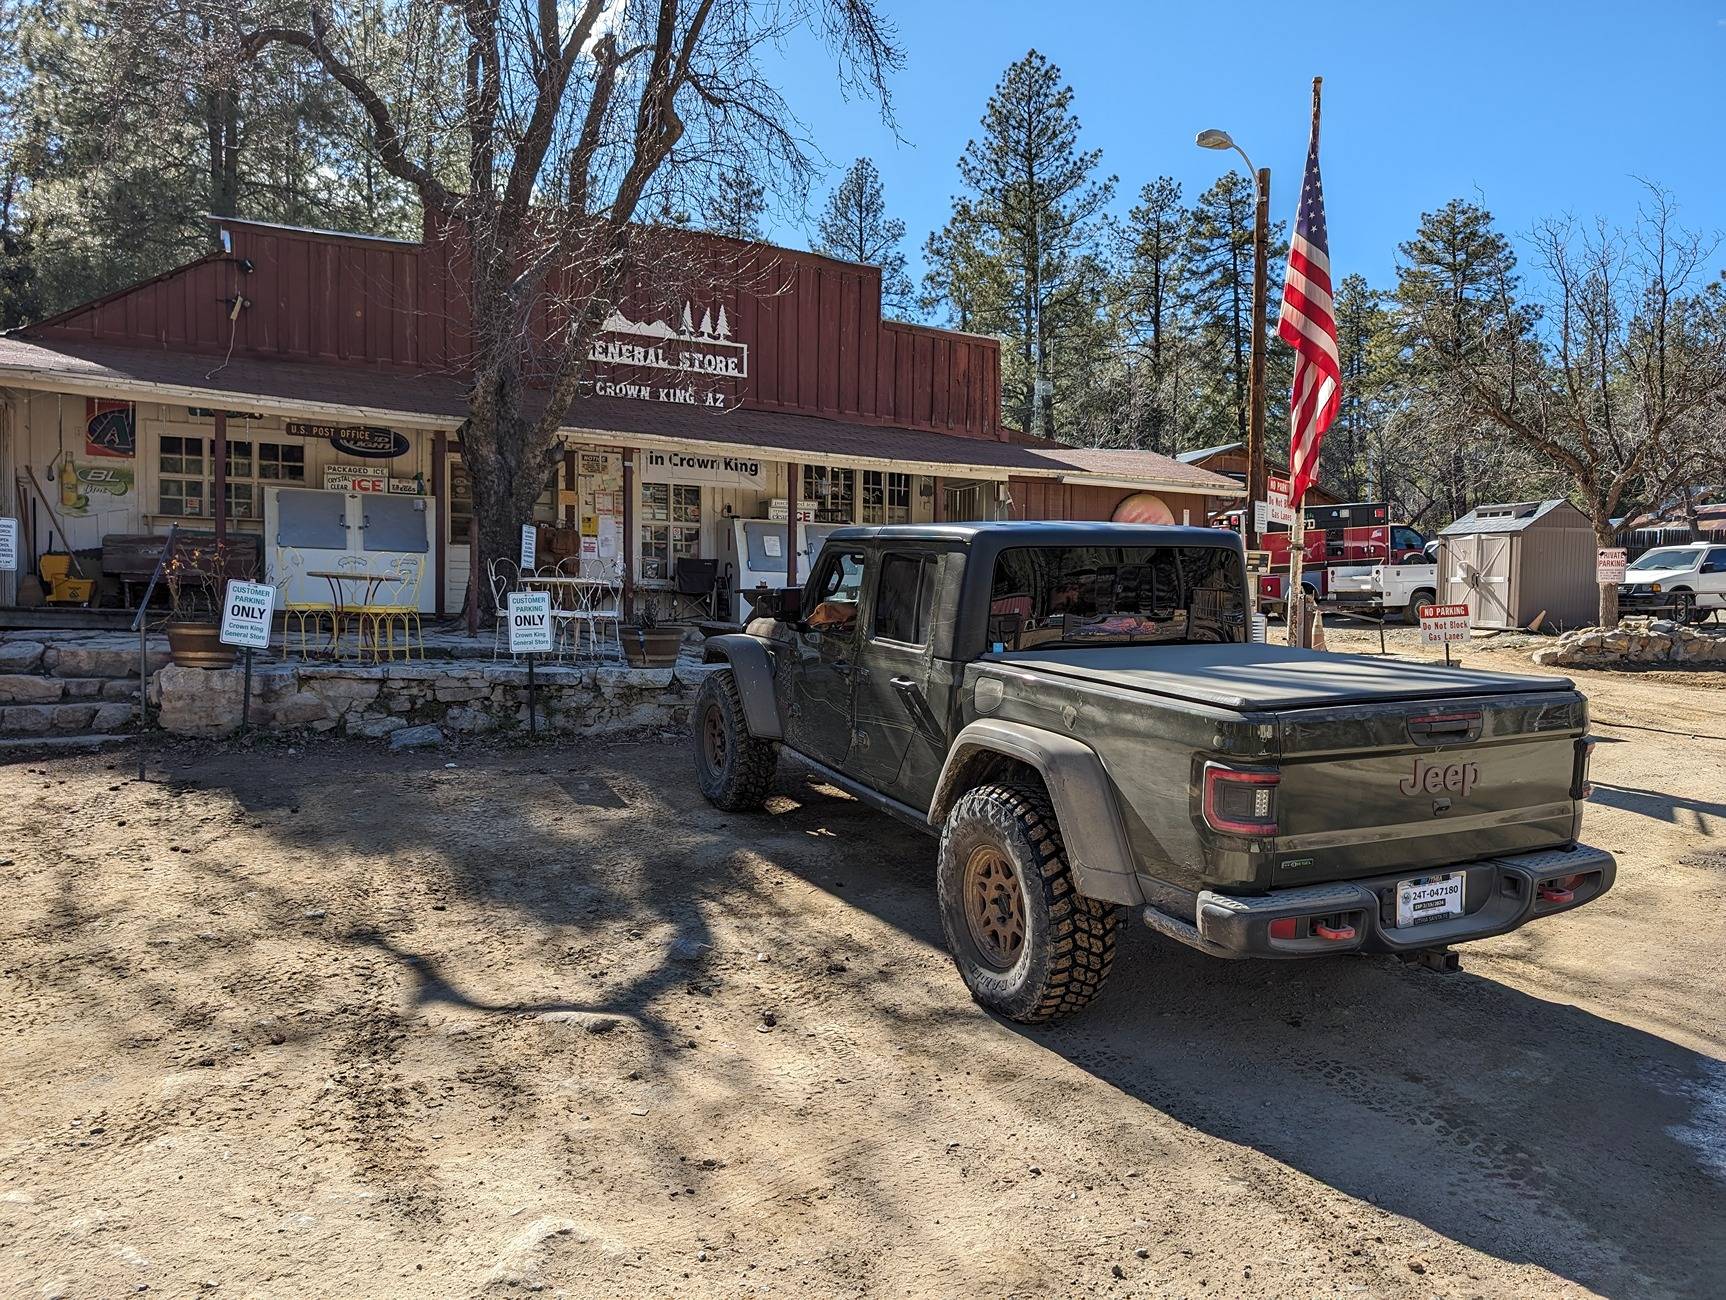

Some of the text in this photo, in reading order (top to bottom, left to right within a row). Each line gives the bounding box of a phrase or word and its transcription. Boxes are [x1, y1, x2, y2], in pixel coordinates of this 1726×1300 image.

[679, 351, 738, 375] STORE
[595, 381, 650, 400] CROWN
[705, 393, 724, 408] AZ
[291, 424, 370, 440] U.S. POST OFFICE
[327, 465, 369, 474] PACKAGED
[649, 451, 759, 476] in Crown King
[87, 469, 120, 481] BL
[327, 475, 351, 484] CRYSTAL
[351, 479, 384, 492] ICE
[796, 511, 811, 523] CE
[1271, 509, 1279, 519] Gas
[1281, 511, 1292, 522] Lanes
[1599, 559, 1625, 568] PARKING
[232, 586, 270, 597] CUSTOMER
[235, 595, 266, 605] PARKING
[231, 605, 267, 620] ONLY
[1424, 606, 1465, 617] NO PARKING
[515, 614, 545, 626] ONLY
[1422, 620, 1468, 630] Do Not Block
[229, 622, 264, 633] Crown King
[224, 629, 266, 641] General Store
[1428, 632, 1464, 641] Gas Lanes
[1400, 757, 1481, 797] Jeep
[1412, 885, 1459, 901] 24T-047180
